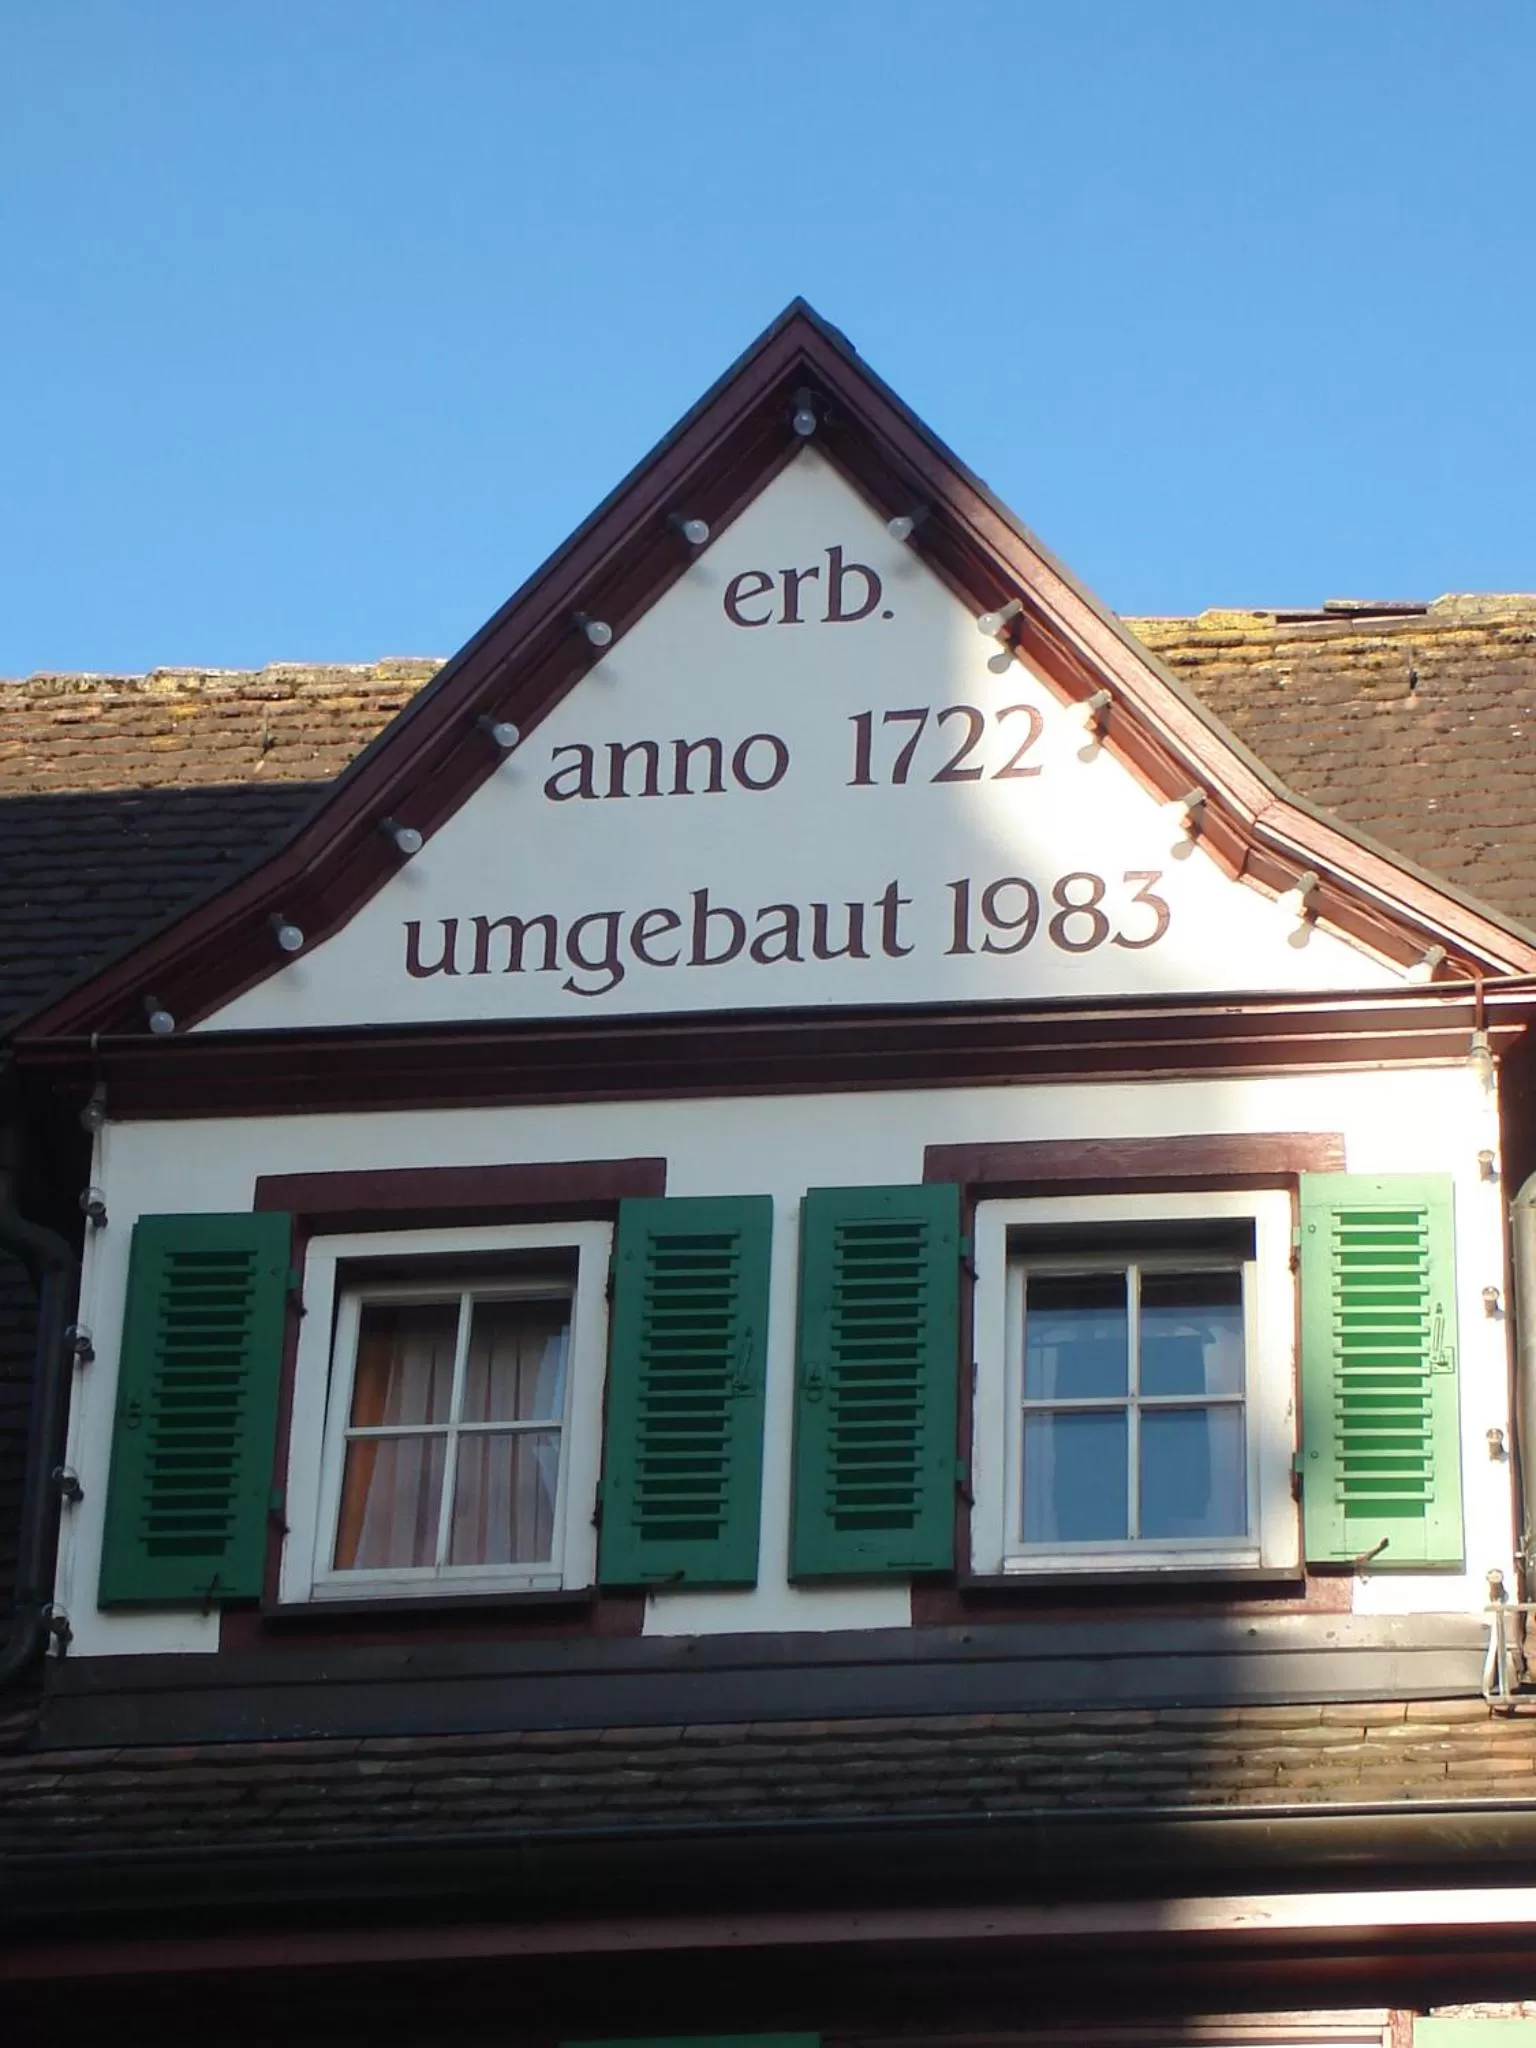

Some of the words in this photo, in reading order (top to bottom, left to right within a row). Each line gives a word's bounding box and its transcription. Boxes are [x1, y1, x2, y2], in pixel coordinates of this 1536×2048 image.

[723, 545, 895, 627] erb.
[543, 734, 790, 801] anno
[846, 704, 1044, 786] 1722
[403, 879, 914, 996] umgebaut
[943, 870, 1171, 956] 1983
